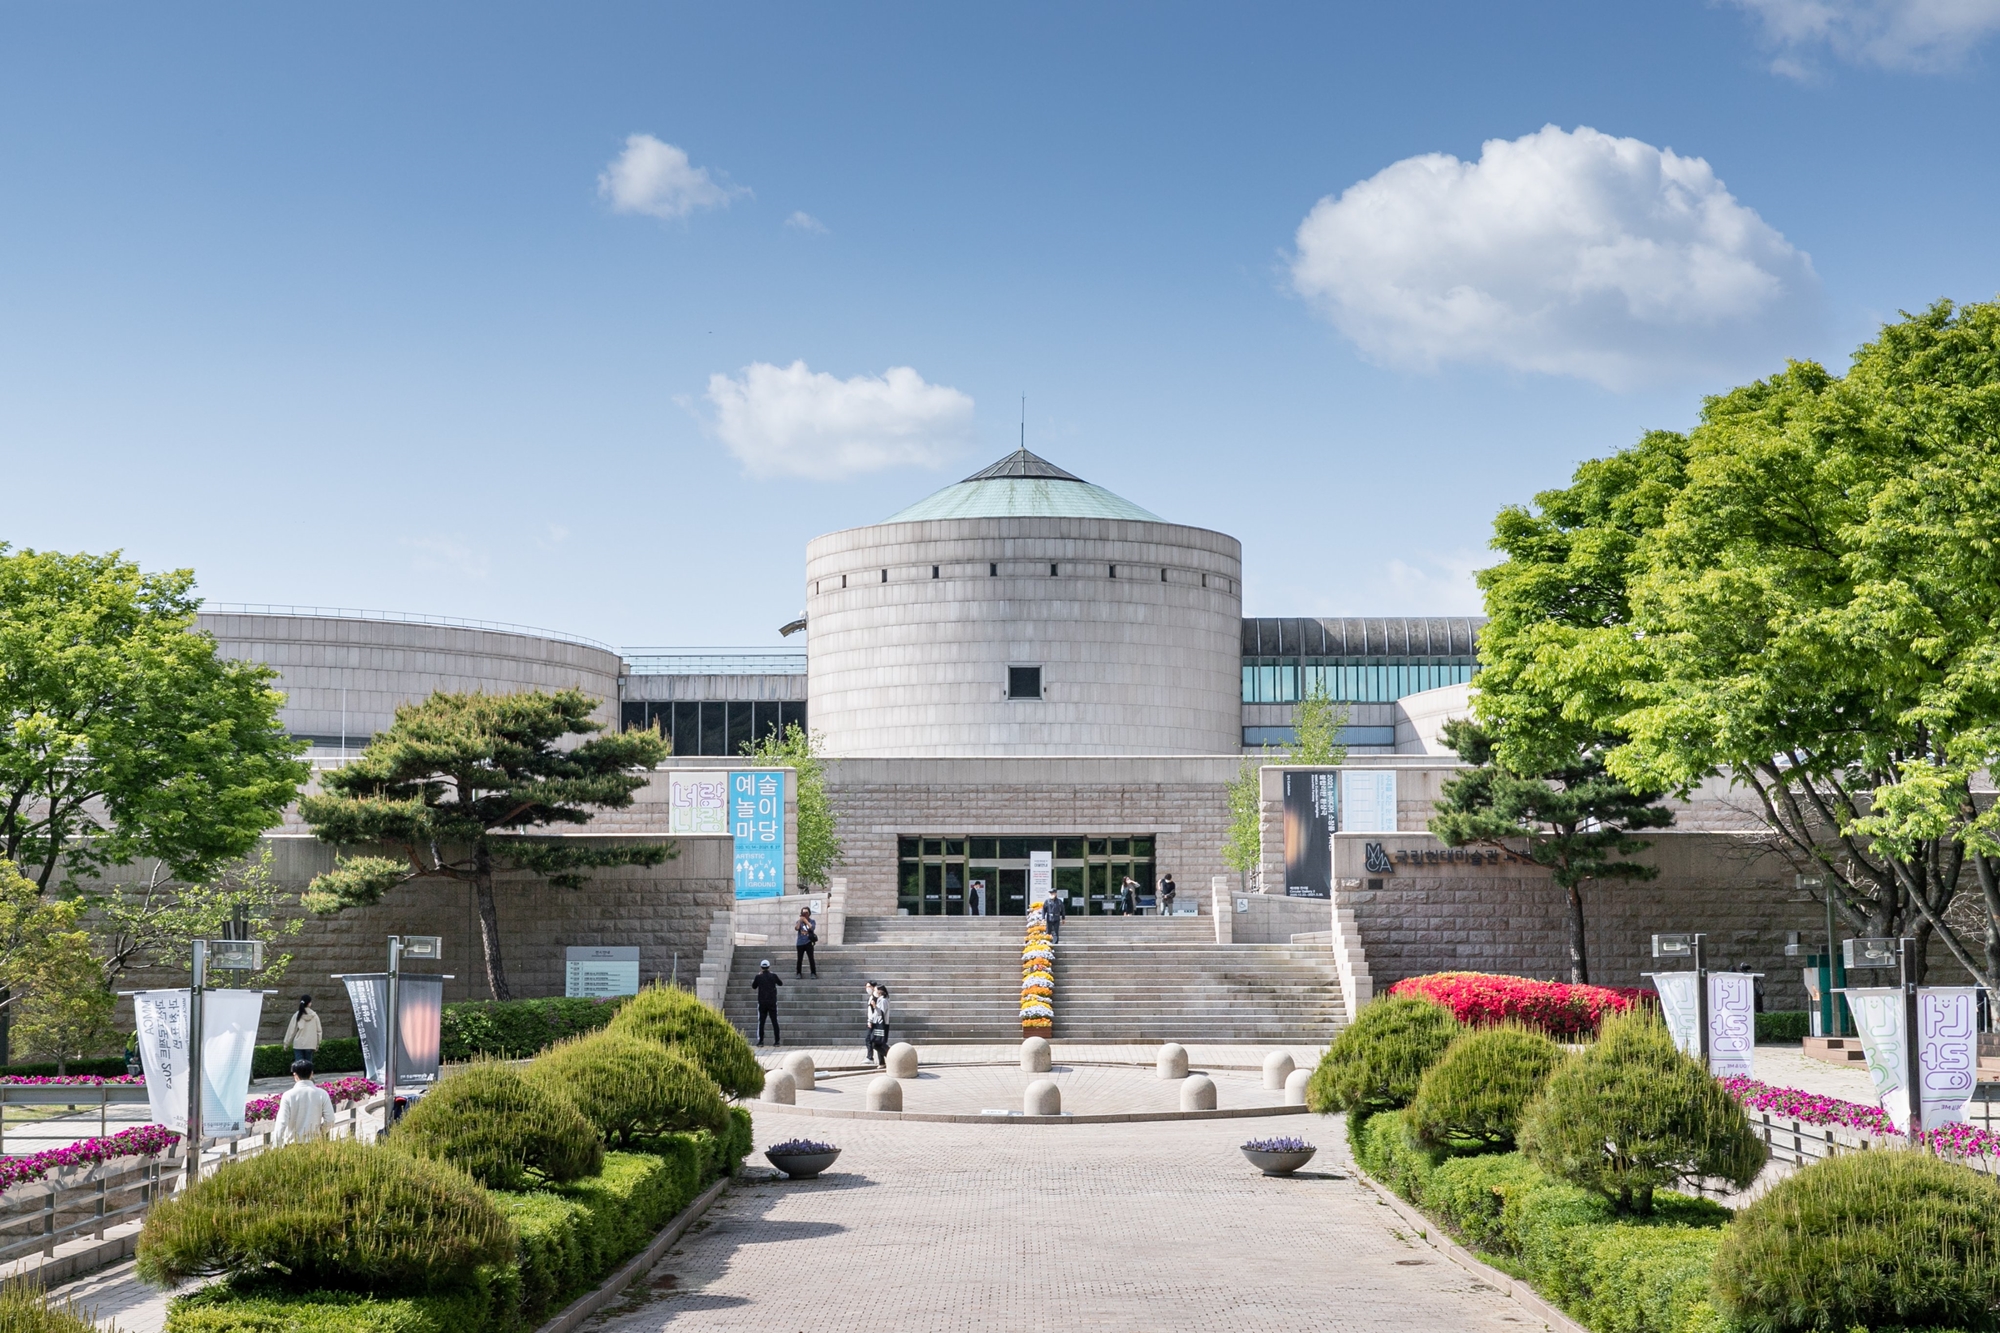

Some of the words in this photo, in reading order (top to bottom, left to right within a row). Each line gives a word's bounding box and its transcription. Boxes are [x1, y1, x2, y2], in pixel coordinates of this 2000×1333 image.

[672, 781, 725, 808] 너랑
[736, 774, 778, 796] 예술
[735, 797, 777, 818] 놀이
[672, 807, 725, 832] 나랑
[736, 820, 779, 841] 마당
[1367, 844, 1393, 873] MMCA
[1395, 849, 1498, 866] 국립현대미술관
